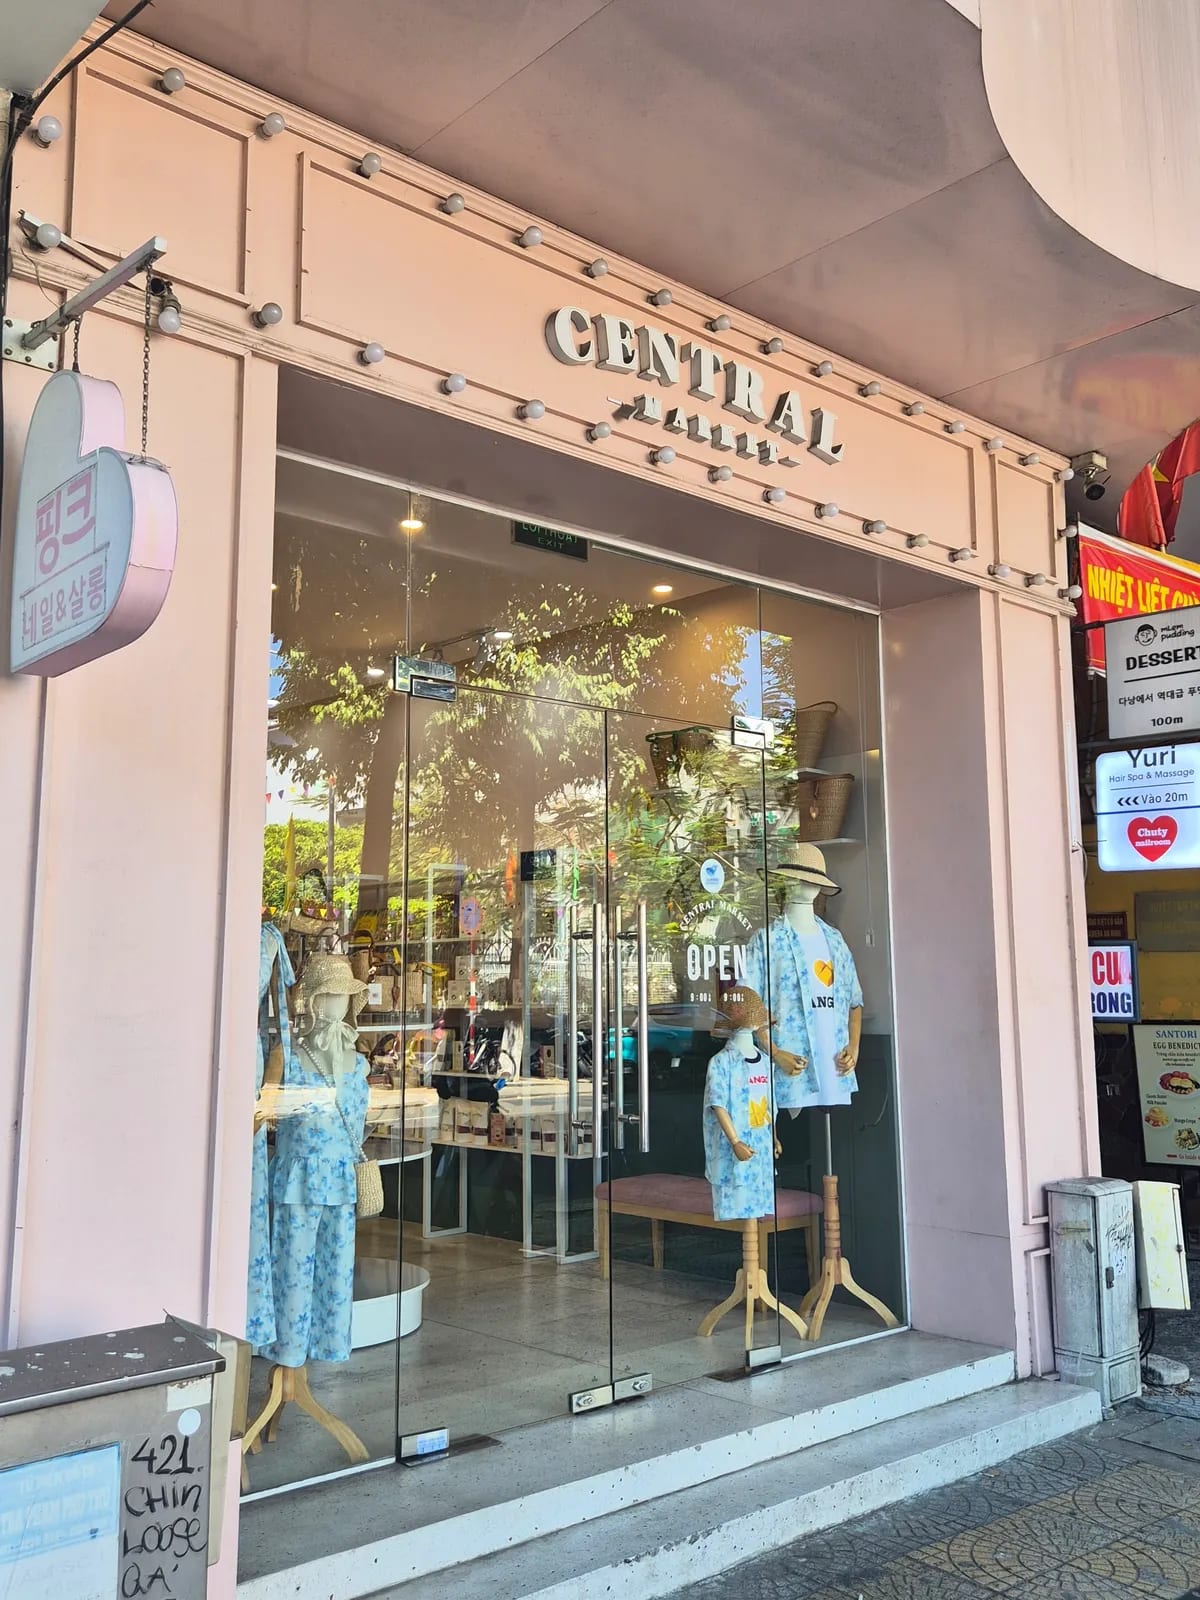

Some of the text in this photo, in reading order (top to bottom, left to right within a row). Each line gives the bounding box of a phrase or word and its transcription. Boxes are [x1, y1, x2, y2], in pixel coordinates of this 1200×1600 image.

[545, 306, 845, 465] CENTRAL
[634, 394, 779, 466] MARKET
[36, 473, 96, 574] 핑크
[538, 537, 564, 549] EXIT
[1087, 564, 1134, 614] NHIỆT
[22, 563, 106, 642] 네일&살롱
[1161, 629, 1195, 642] pudding
[1119, 693, 1154, 706] 다낭에서
[1151, 716, 1183, 727] 100m
[1127, 745, 1176, 768] Yuri
[1109, 775, 1125, 783] Hair
[1128, 773, 1144, 783] Spa
[1155, 768, 1195, 778] Massage
[1165, 792, 1188, 803] 20m
[719, 900, 753, 932] MARKET
[687, 943, 747, 981] OPEN
[1155, 1030, 1197, 1039] SANTORI
